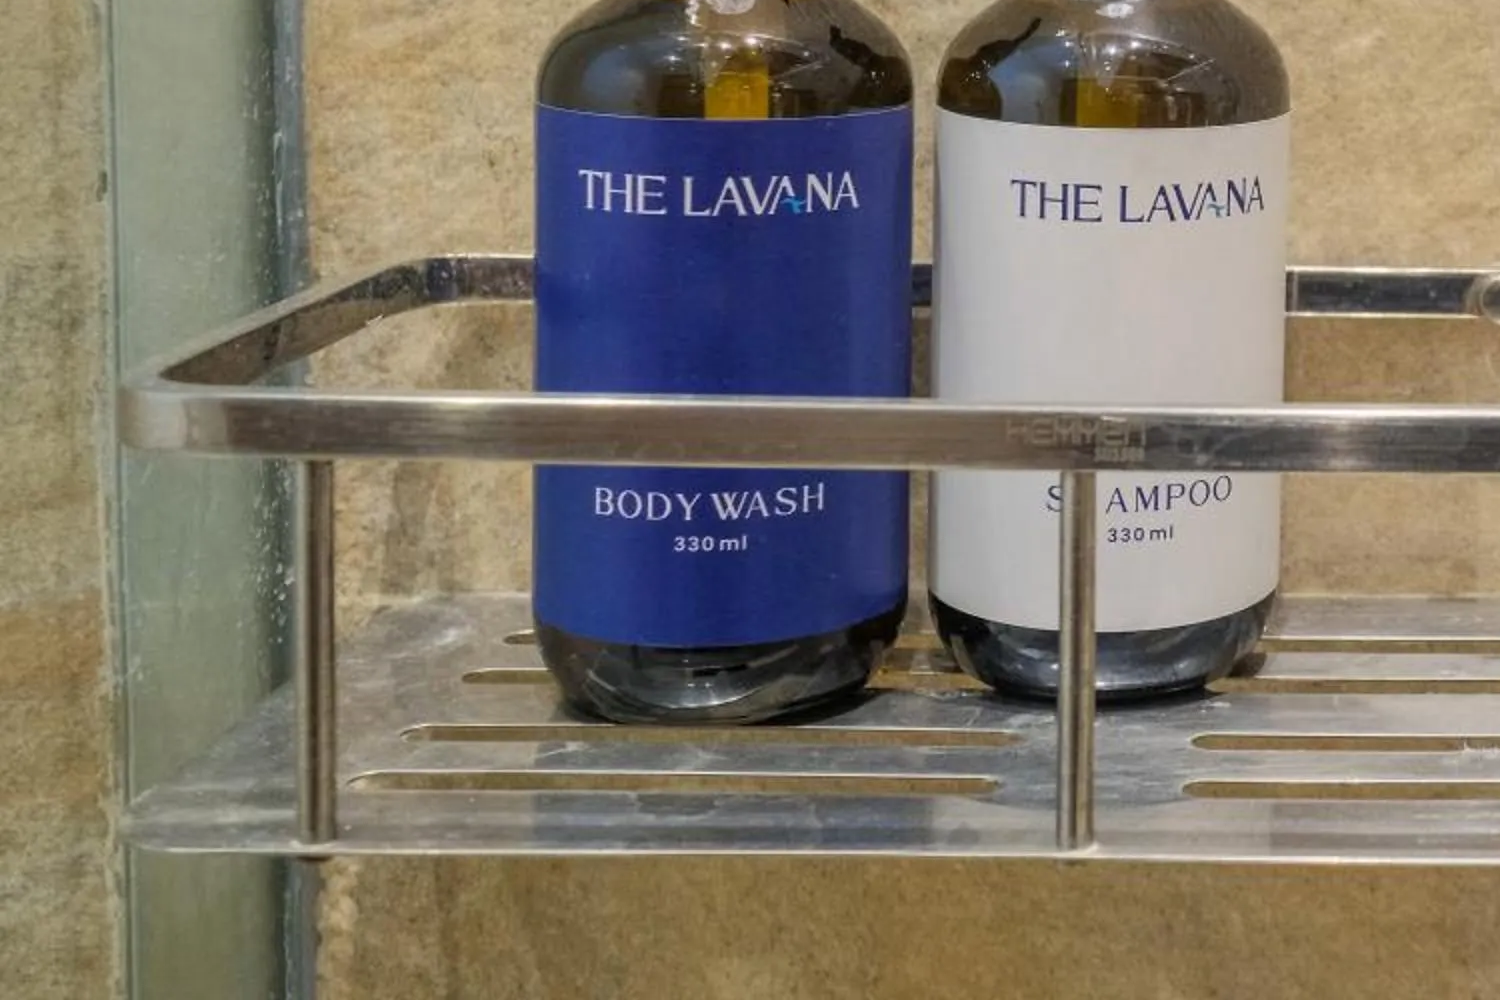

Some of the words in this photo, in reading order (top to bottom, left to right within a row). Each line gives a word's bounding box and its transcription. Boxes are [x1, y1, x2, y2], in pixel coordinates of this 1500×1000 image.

[578, 168, 668, 216] THE
[682, 171, 861, 217] LAVANA
[1010, 179, 1103, 223] THE
[1118, 175, 1265, 223] LAVANA
[594, 486, 702, 521] BODY
[709, 482, 826, 521] WASH
[1046, 474, 1233, 514] SAMPOO
[673, 535, 715, 552] 330
[718, 533, 748, 551] ml
[1106, 527, 1146, 543] 330
[1149, 525, 1174, 541] ml
